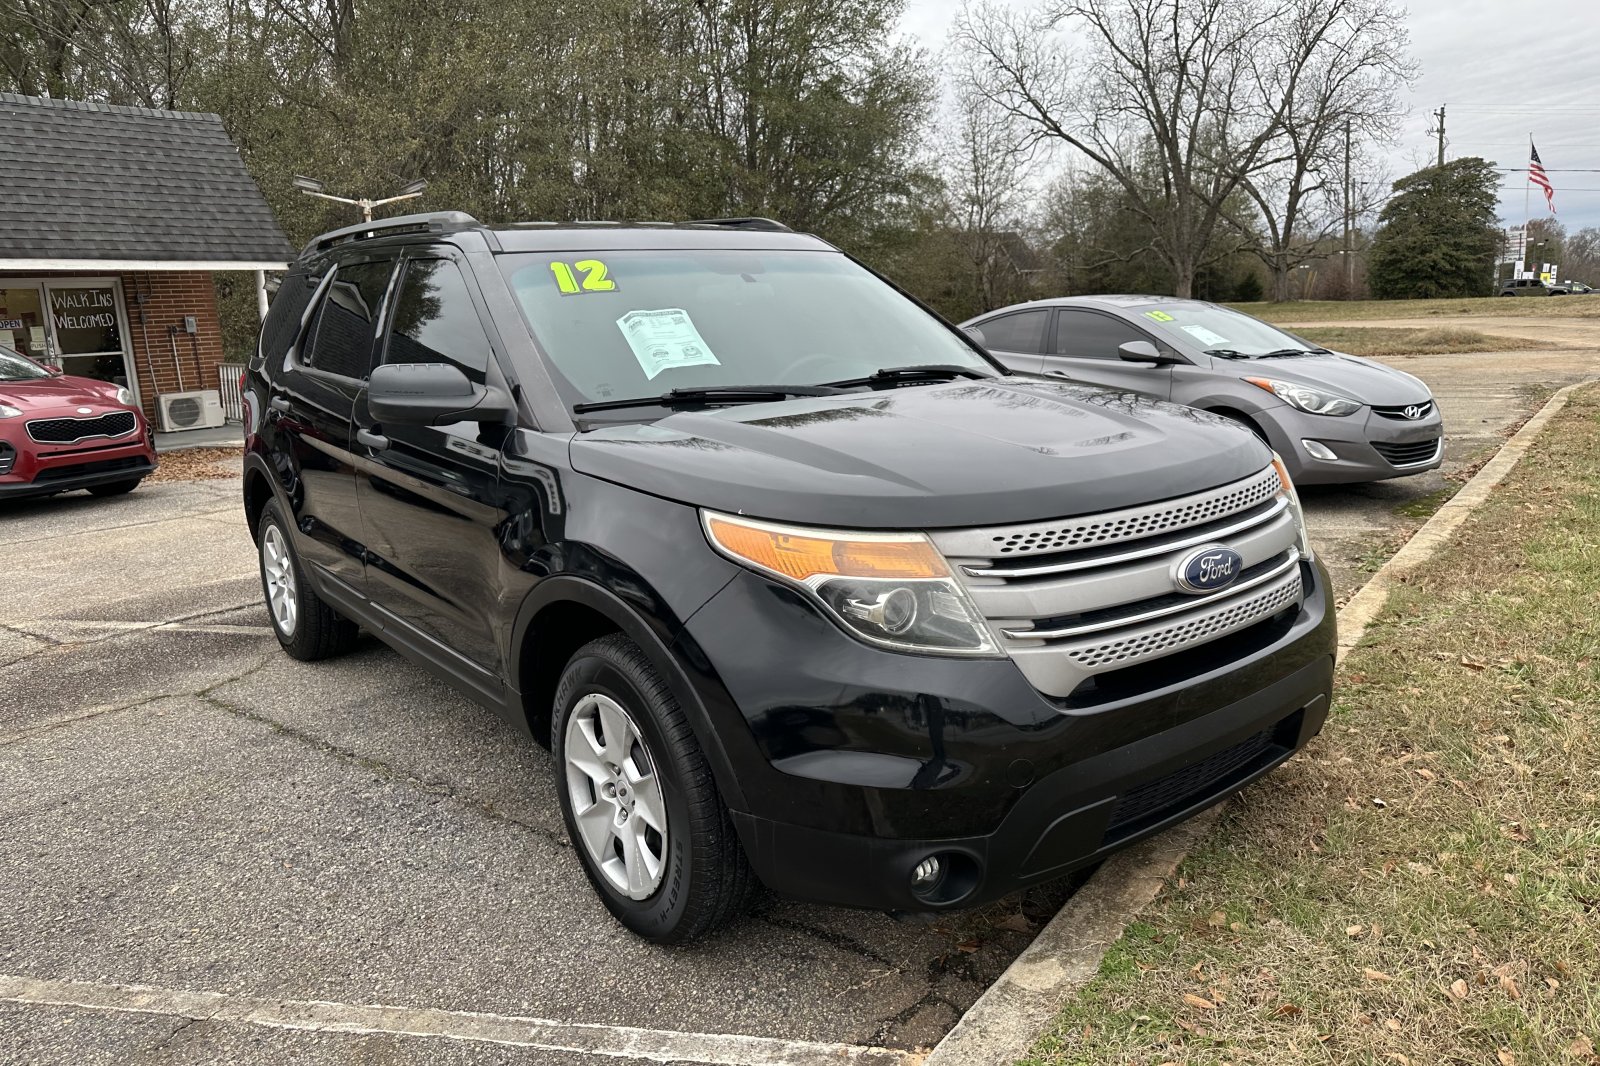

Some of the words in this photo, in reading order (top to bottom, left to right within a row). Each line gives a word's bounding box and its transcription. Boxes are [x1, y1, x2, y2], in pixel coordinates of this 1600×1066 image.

[550, 259, 616, 294] 12
[51, 290, 90, 309] WALK
[53, 312, 114, 329] WELCOMED
[1200, 553, 1233, 583] Ford
